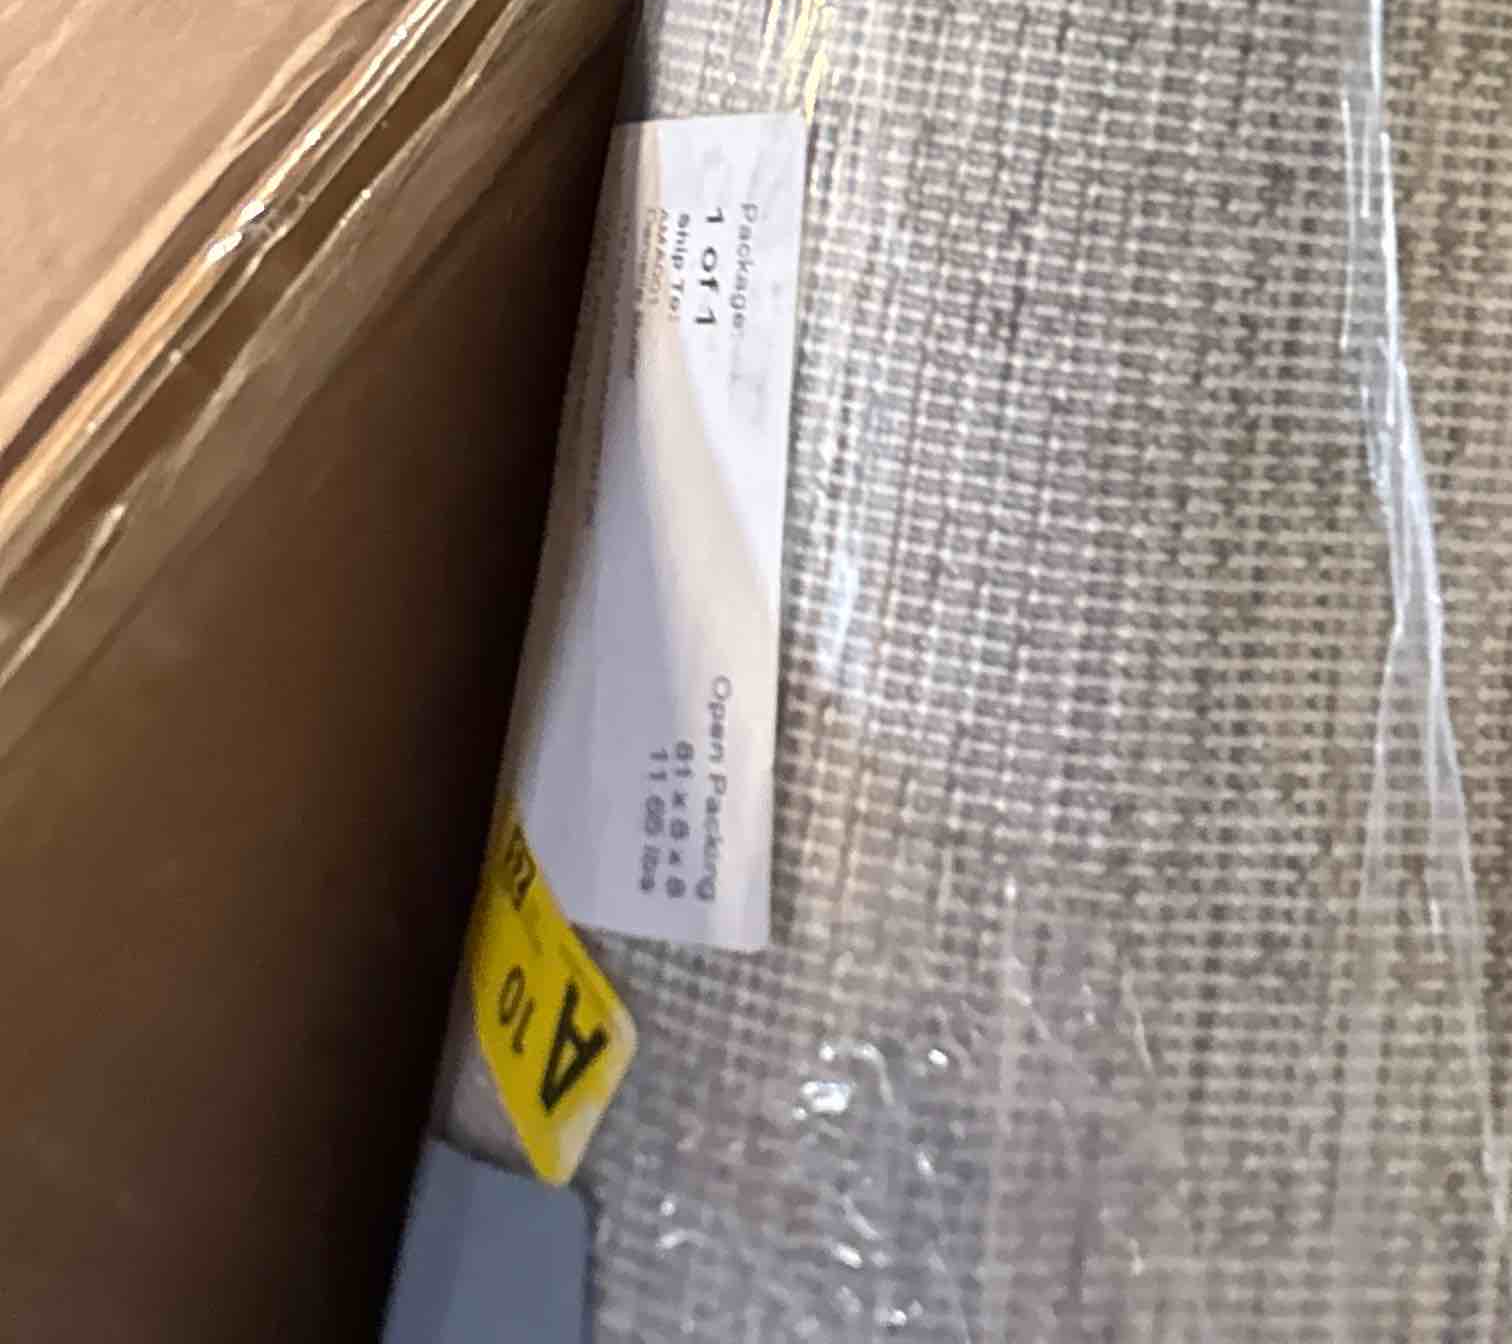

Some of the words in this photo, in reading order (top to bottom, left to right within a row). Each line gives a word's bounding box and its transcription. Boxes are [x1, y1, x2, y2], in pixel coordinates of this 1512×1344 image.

[670, 213, 691, 271] Ship
[704, 207, 725, 225] 1
[697, 245, 722, 294] of
[693, 308, 719, 326] 1
[707, 675, 734, 764] Open
[695, 772, 729, 903] Packing
[638, 845, 663, 893] lbs
[539, 978, 609, 1114] A
